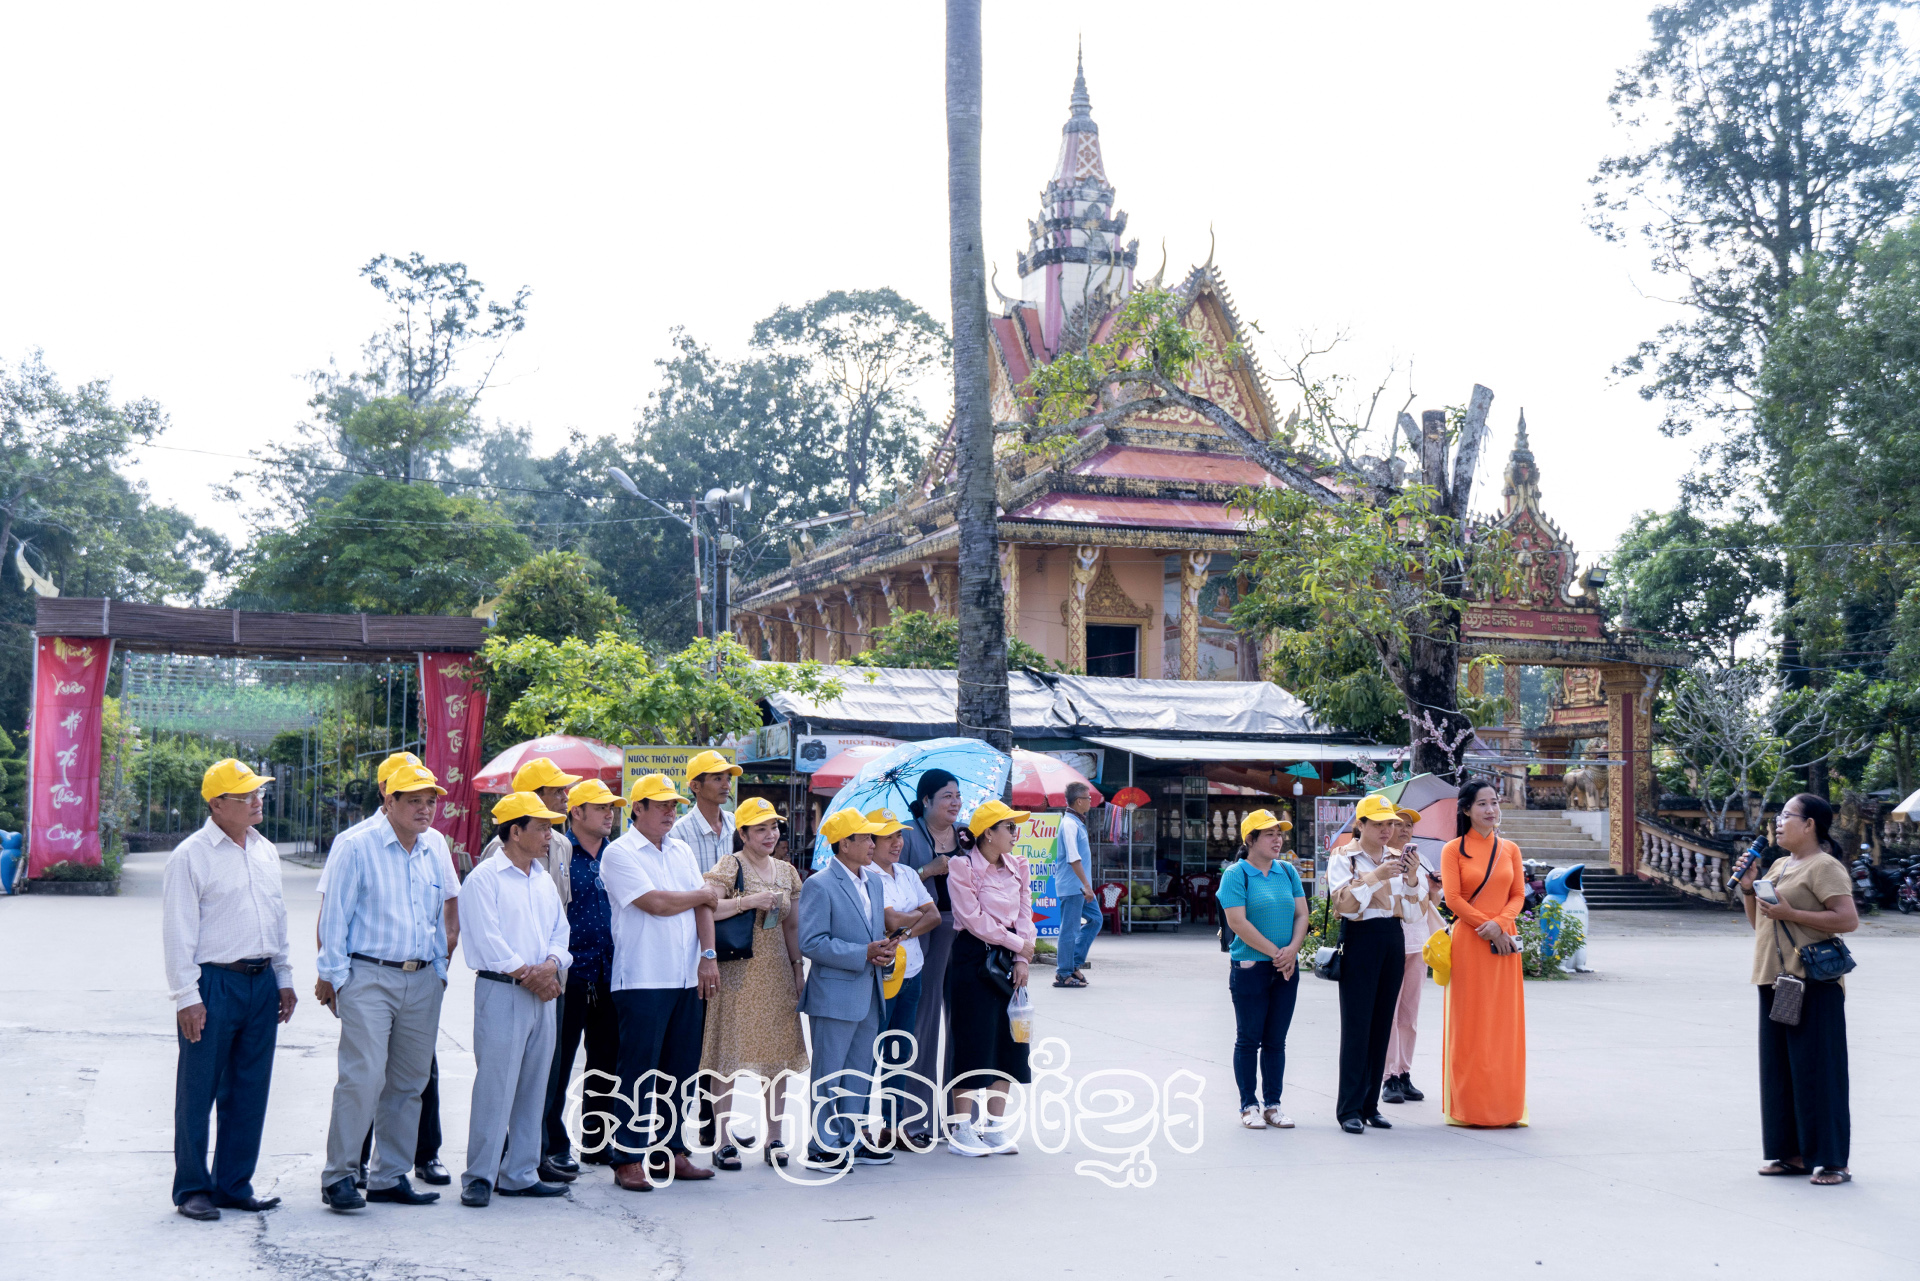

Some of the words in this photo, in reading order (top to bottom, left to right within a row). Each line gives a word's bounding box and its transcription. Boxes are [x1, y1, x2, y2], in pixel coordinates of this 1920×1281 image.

[53, 636, 97, 667] Mừng
[51, 674, 86, 696] Xuân
[445, 694, 469, 719] Tết
[628, 753, 650, 763] NƯỚC
[651, 753, 671, 764] THỐT
[673, 753, 689, 764] NỐT
[446, 765, 464, 784] Bi
[631, 767, 658, 776] ĐƯỜNG
[659, 766, 680, 776] THỐT
[1025, 818, 1057, 838] Kim
[1035, 861, 1048, 876] DÂN
[1048, 860, 1057, 878] TỘ
[1035, 896, 1057, 909] NIỆM
